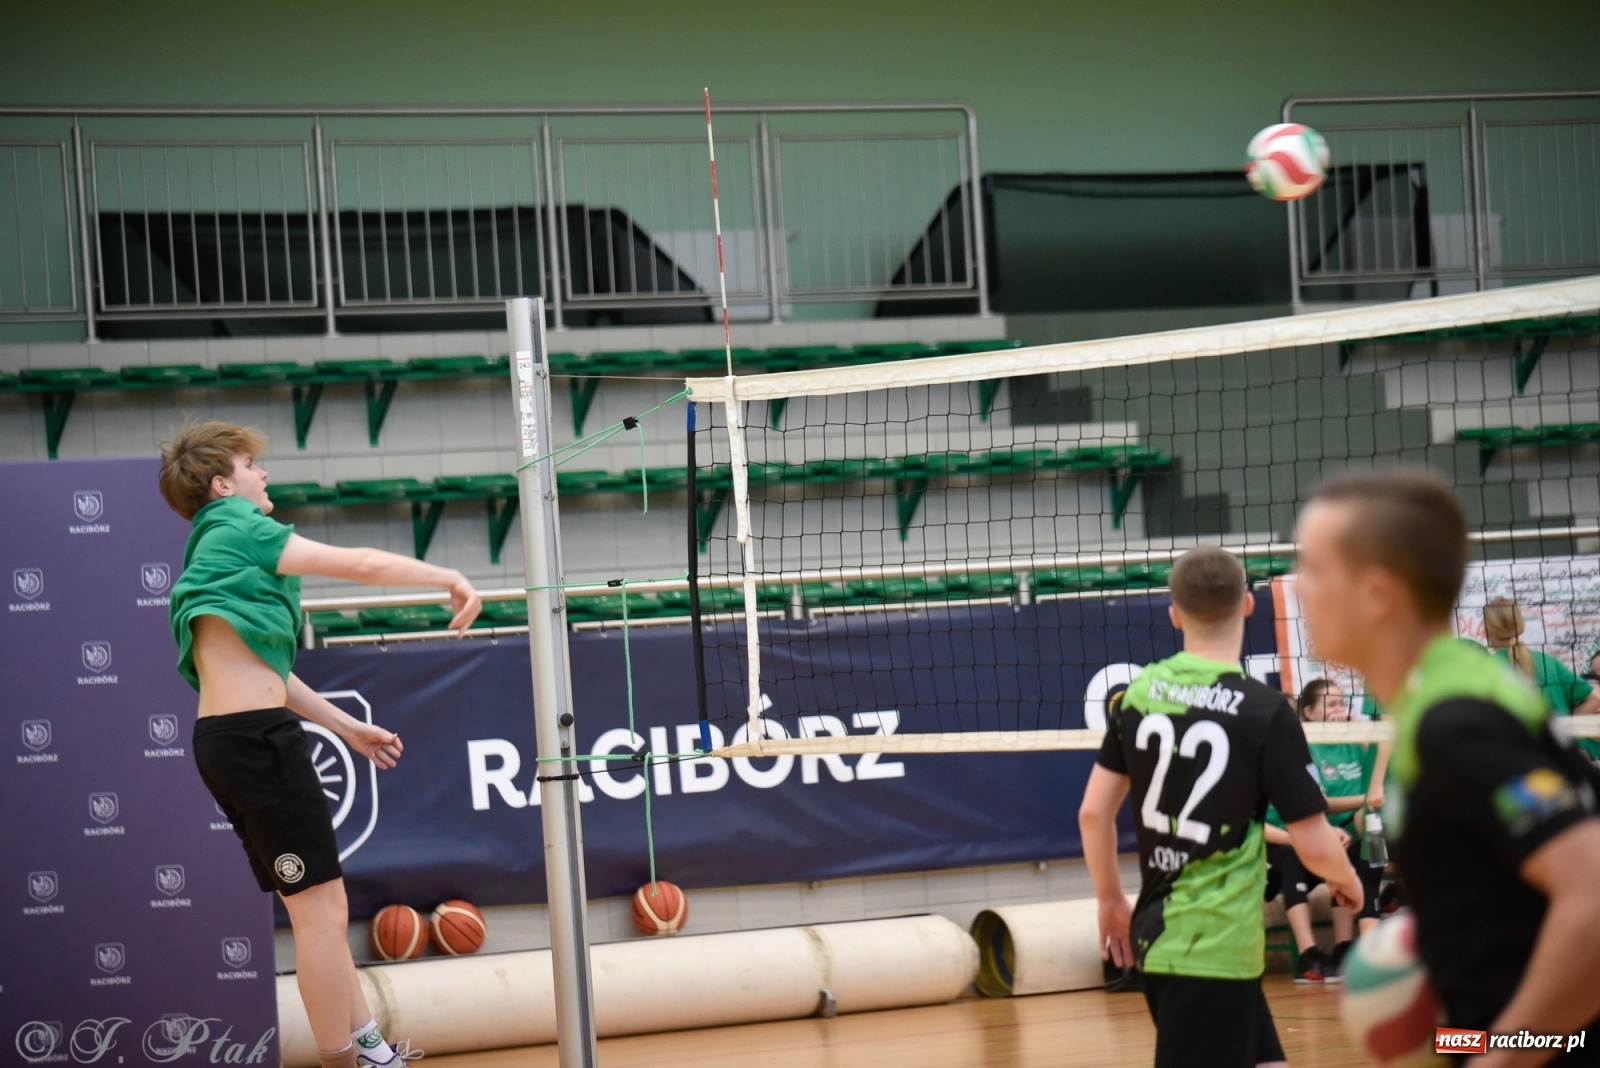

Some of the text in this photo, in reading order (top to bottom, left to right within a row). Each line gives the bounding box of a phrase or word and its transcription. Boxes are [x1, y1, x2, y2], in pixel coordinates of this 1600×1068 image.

[467, 693, 906, 811] RCIBÓRZ
[1168, 681, 1245, 716] RACIBÓRZ
[1135, 712, 1230, 845] 22
